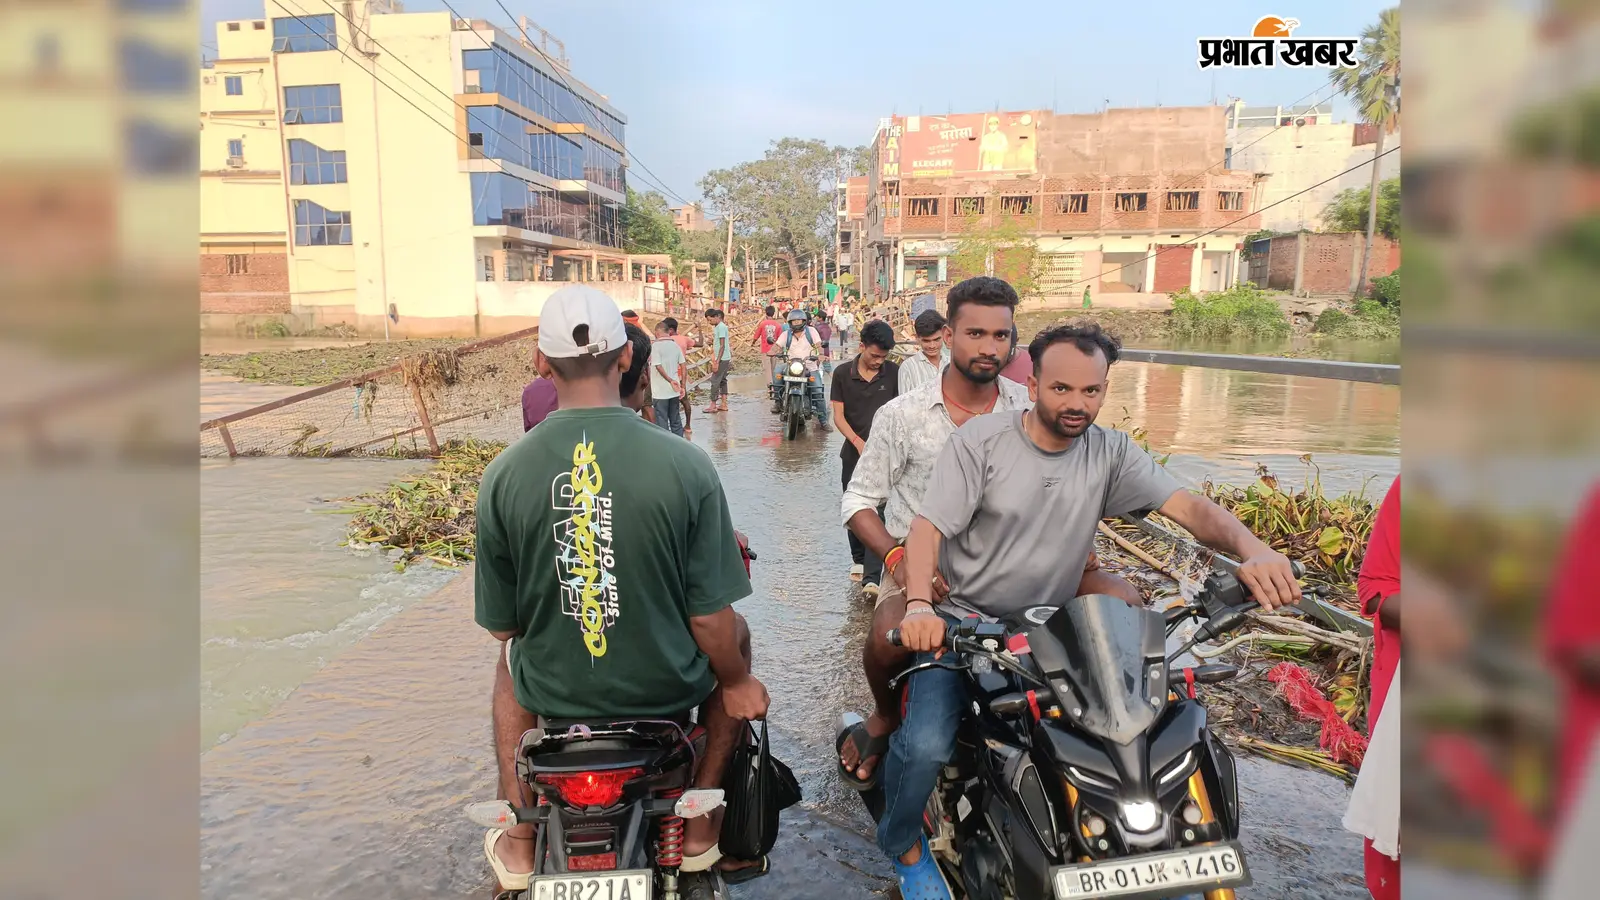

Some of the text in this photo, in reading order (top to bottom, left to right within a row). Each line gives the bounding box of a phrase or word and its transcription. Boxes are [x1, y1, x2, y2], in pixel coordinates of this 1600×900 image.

[886, 126, 901, 137] THE
[940, 123, 973, 140] भरोसा
[600, 491, 620, 618] State Of Mind.
[553, 878, 632, 900] BR21A
